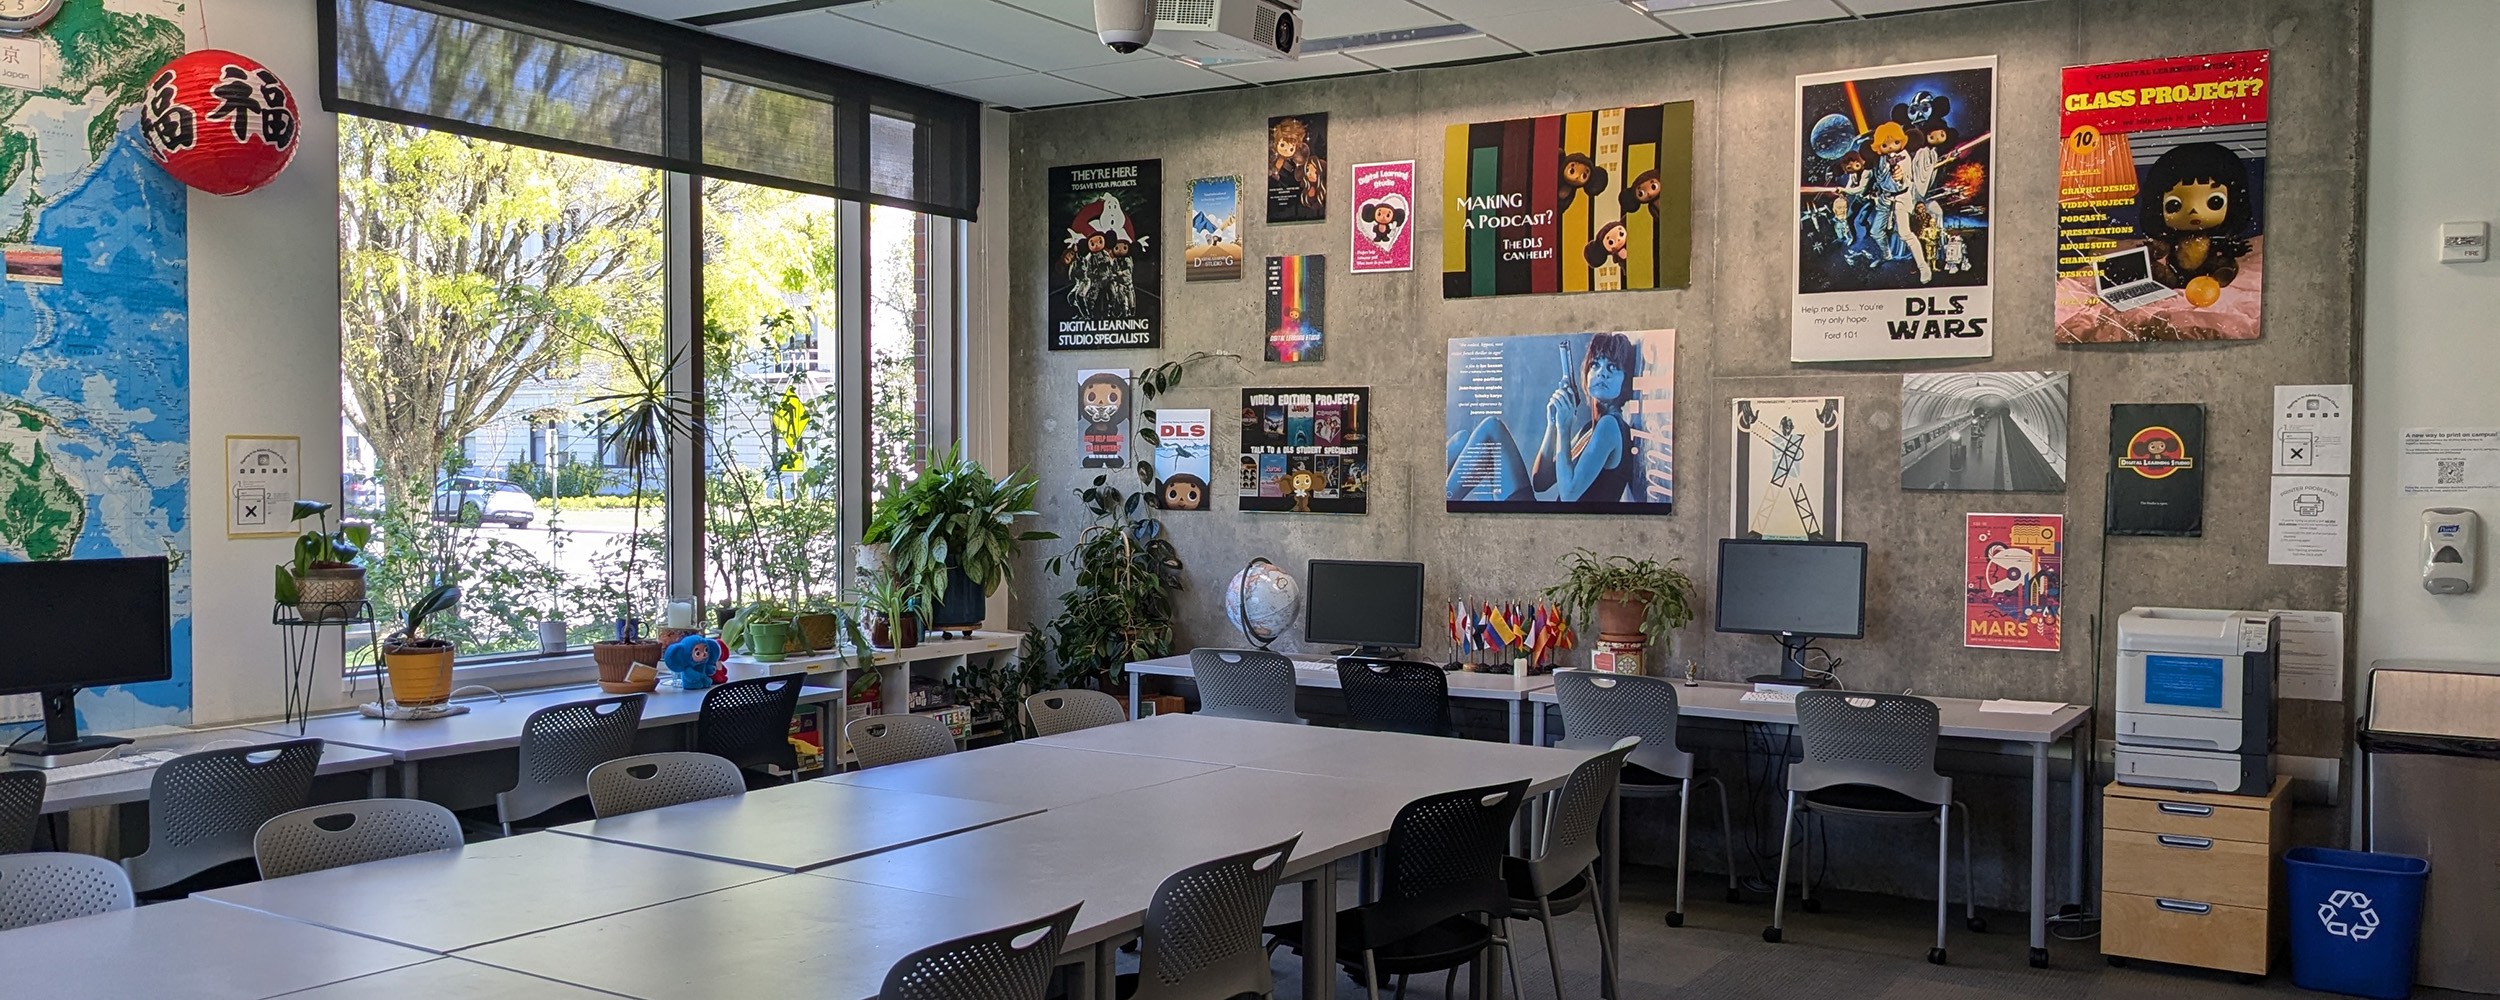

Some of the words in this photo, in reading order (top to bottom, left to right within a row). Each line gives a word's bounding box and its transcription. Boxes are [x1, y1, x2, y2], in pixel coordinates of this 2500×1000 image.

[2, 69, 29, 79] Japan
[2114, 69, 2150, 79] DIGITAL
[2065, 89, 2136, 112] CLASS
[2140, 78, 2264, 106] PROJECT?
[207, 65, 295, 151] 福
[1071, 168, 1111, 181] THEY'RE
[1112, 166, 1138, 179] HERE
[1358, 171, 1379, 185] Digital
[1380, 170, 1408, 181] Learning
[1094, 181, 1110, 189] YOUR
[1373, 179, 1395, 189] Studio
[2061, 186, 2103, 195] GRAPHIC
[2103, 184, 2136, 192] DESIGN
[1457, 193, 1522, 211] MAKING
[2061, 201, 2089, 209] VIDEO
[2090, 198, 2135, 207] PROJECTS
[1463, 218, 1475, 229] A
[1479, 209, 1553, 229] PODCAST?
[2060, 214, 2107, 223] PODCASTS
[2060, 226, 2133, 236] PRESENTATIONS
[1502, 239, 1521, 250] THE
[1523, 237, 1543, 249] DLS
[2060, 242, 2090, 250] ADOBE
[2091, 241, 2117, 249] SUITE
[1502, 252, 1525, 261] CAN
[1525, 248, 1553, 259] HELP!
[2059, 256, 2106, 265] CHARGERS
[2059, 270, 2105, 278] DESKTOPS
[1836, 304, 1857, 312] DLS...
[1859, 303, 1884, 311] You're
[1906, 295, 1968, 316] DLS
[1828, 316, 1845, 324] only
[1846, 315, 1869, 324] hope.
[1060, 320, 1097, 332] DIGITAL
[1099, 319, 1149, 330] LEARNING
[1887, 318, 1987, 340] WARS
[1058, 334, 1094, 345] STUDIO
[1094, 332, 1150, 345] SPECIALISTS
[1843, 331, 1858, 339] 101
[1250, 394, 1275, 406] VIDEO
[1278, 394, 1312, 406] EDITING
[1315, 393, 1360, 405] PROJECT?
[1291, 405, 1309, 413] JAWS
[1160, 425, 1206, 437] DLS
[1250, 446, 1264, 454] TALK
[1267, 446, 1274, 454] TO
[1276, 446, 1281, 454] A
[1296, 446, 1322, 454] STUDENT
[1324, 446, 1359, 454] SPECIALIST!
[2280, 485, 2303, 497] PRINTER
[1970, 619, 2029, 637] MARS
